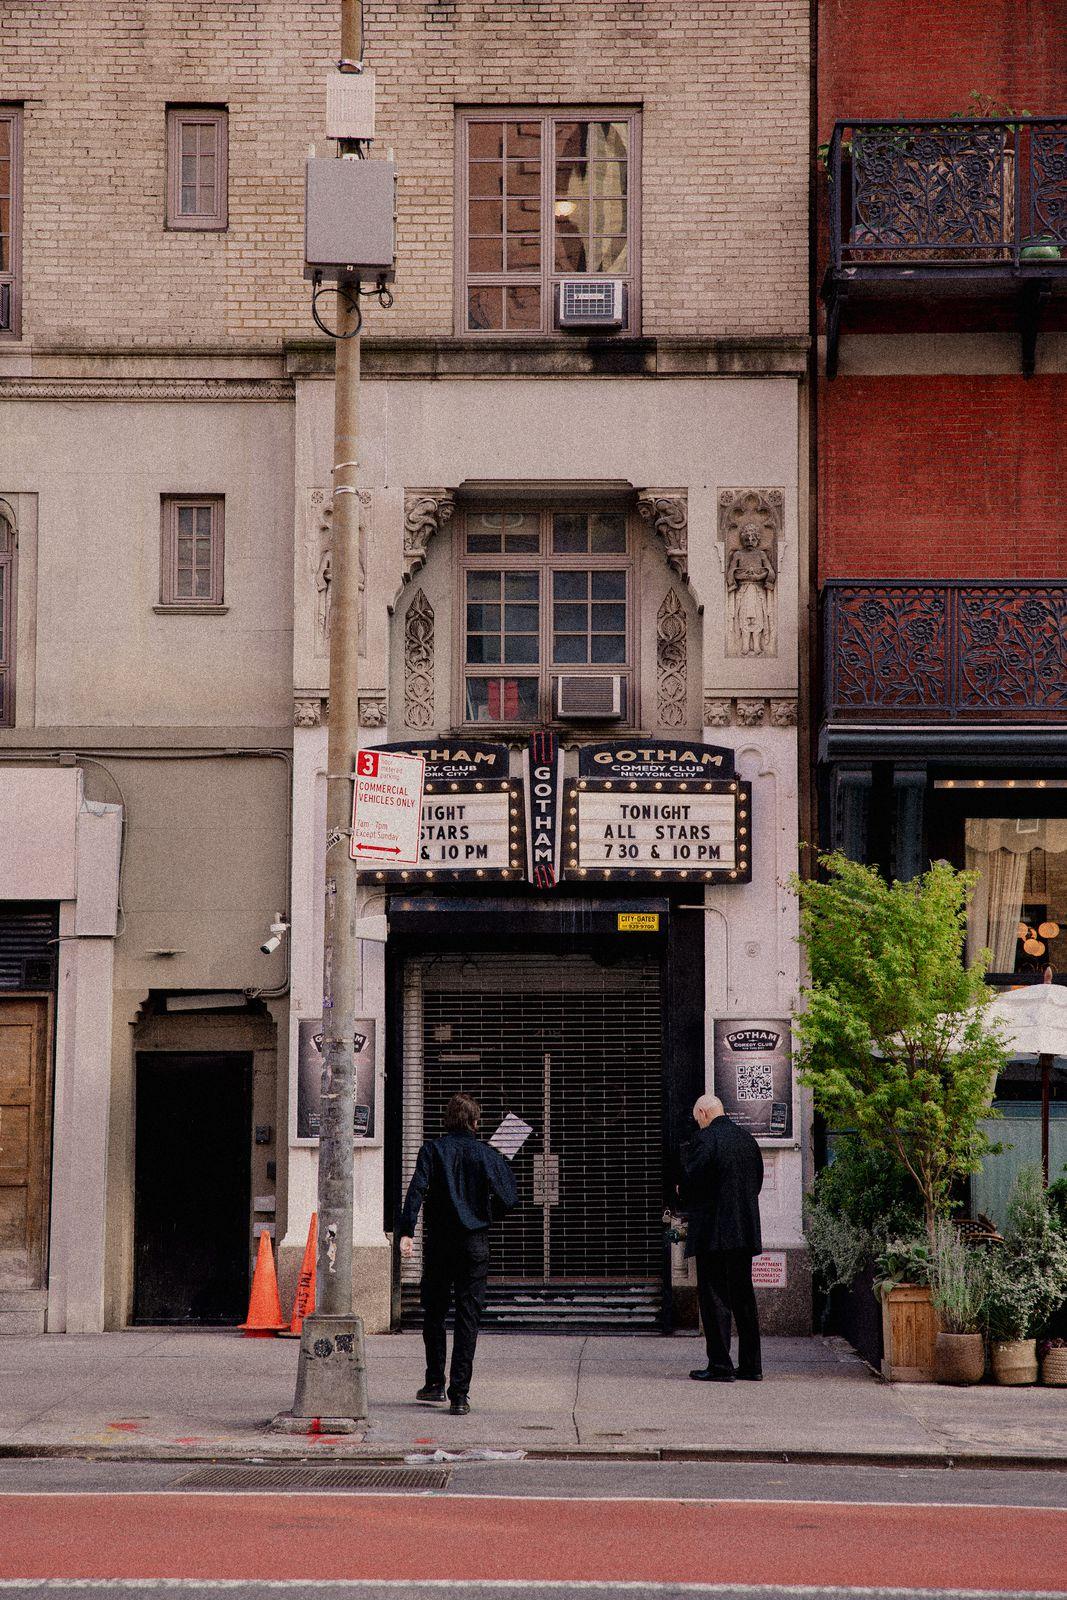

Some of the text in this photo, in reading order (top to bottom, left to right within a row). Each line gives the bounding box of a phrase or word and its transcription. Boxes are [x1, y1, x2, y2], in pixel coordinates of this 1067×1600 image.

[363, 754, 373, 775] 3
[398, 749, 496, 765] THAM
[594, 750, 723, 766] GOTHAM
[360, 782, 408, 796] COMMERCIAL
[359, 794, 415, 808] VEHICLES ONLY
[422, 805, 465, 820] IGHT
[534, 766, 552, 862] GOTHAM
[620, 805, 691, 820] TONIGHT
[356, 829, 399, 841] Except Sunday
[604, 825, 710, 840] ALL STARS
[420, 844, 488, 860] & 10 PM
[651, 845, 660, 859] &
[673, 845, 690, 859] 10
[698, 845, 721, 859] PM
[729, 1031, 777, 1042] GOTHAM
